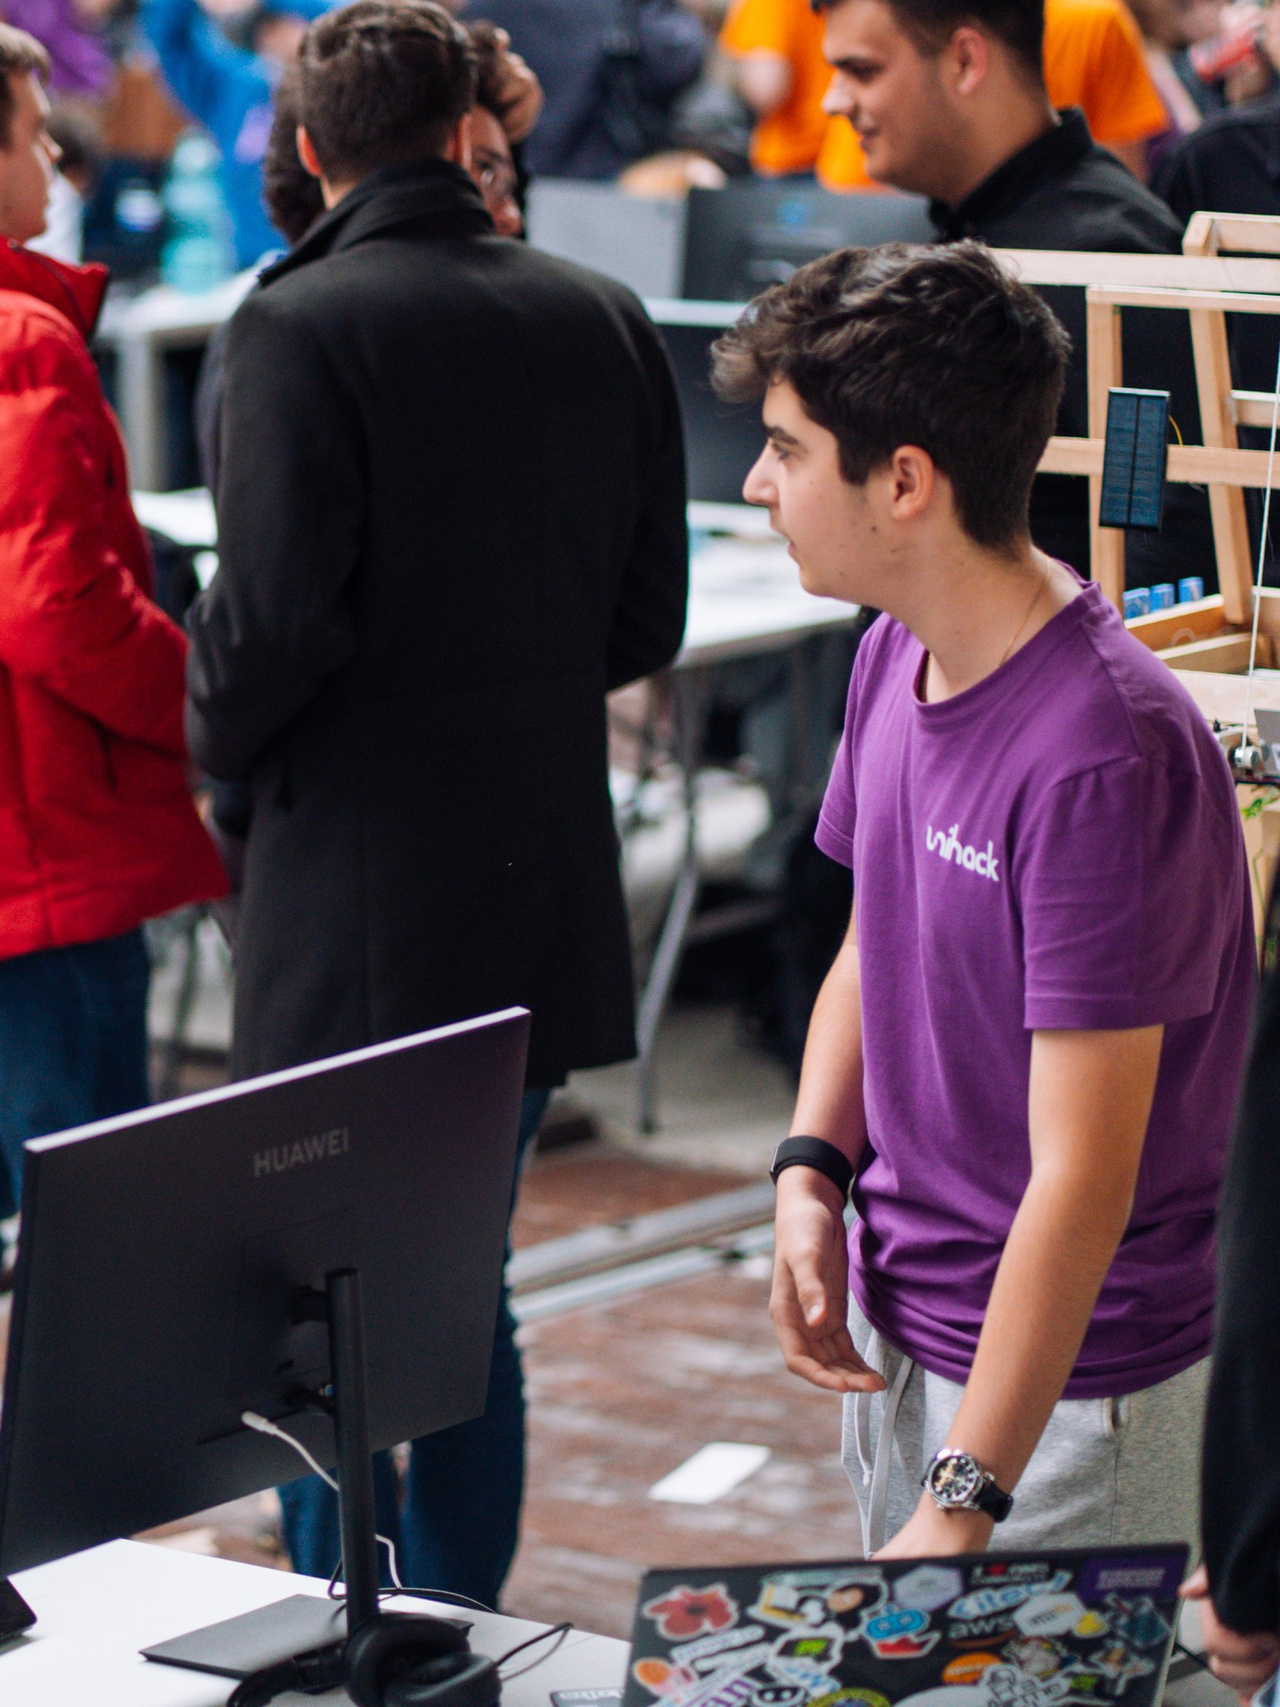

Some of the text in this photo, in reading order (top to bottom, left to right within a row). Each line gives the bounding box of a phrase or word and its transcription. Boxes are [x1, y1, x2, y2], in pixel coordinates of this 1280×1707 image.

[926, 823, 999, 881] unihack
[254, 1128, 348, 1178] HUAWEI
[948, 1613, 1015, 1638] aws
